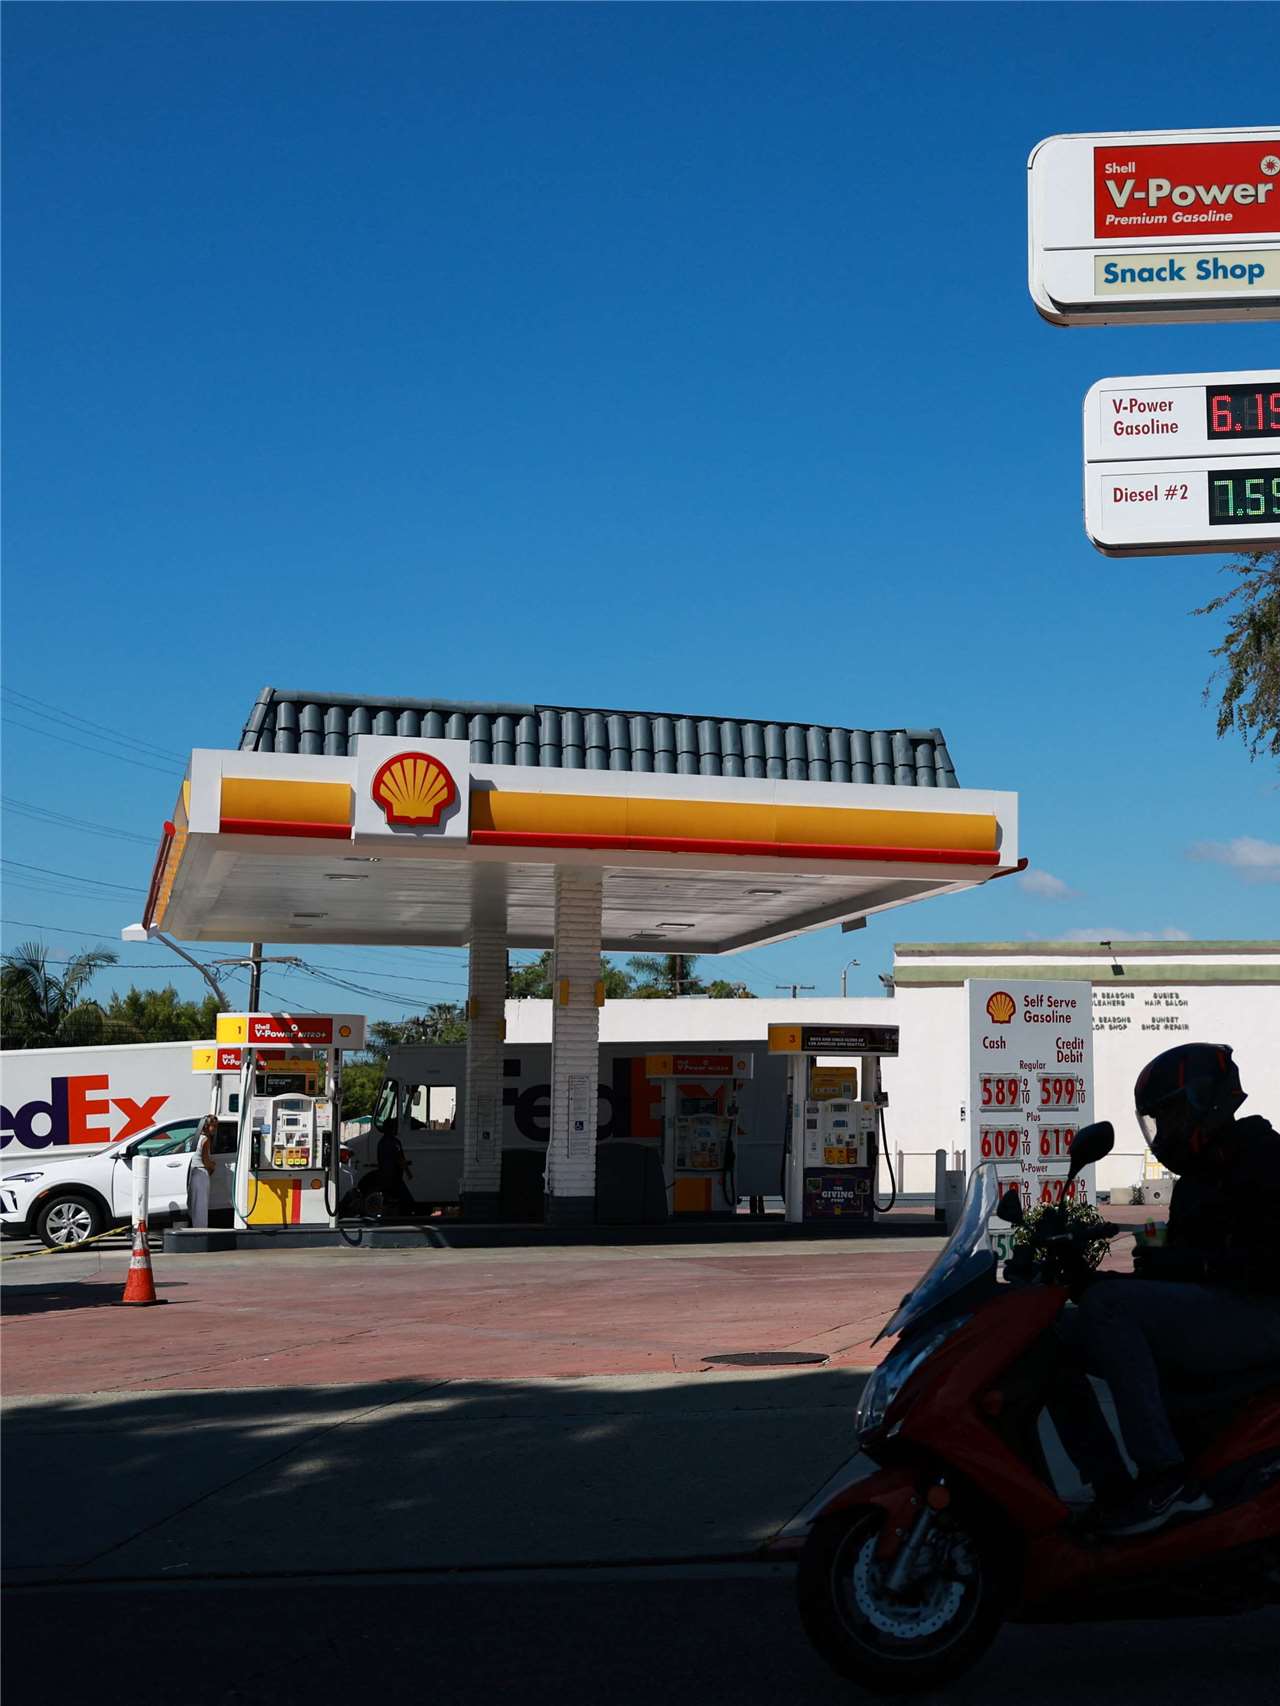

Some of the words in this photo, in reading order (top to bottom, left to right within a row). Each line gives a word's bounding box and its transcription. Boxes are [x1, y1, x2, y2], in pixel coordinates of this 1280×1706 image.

[1104, 162, 1136, 174] Shell
[1105, 178, 1274, 208] V-Power
[1105, 212, 1168, 225] Premium
[1172, 210, 1233, 224] Gasoline
[1104, 258, 1187, 284] Snack
[1196, 257, 1266, 285] Shop
[1112, 398, 1174, 414] V-Power
[1113, 418, 1179, 436] Gasoline
[1113, 484, 1158, 503] Diesel
[1164, 484, 1189, 501] #2
[1023, 994, 1044, 1008] Self
[1047, 996, 1077, 1008] Serve
[1023, 1010, 1072, 1023] Gasoline
[982, 1035, 1006, 1049] Cash
[1056, 1037, 1084, 1050] Credit
[1057, 1050, 1083, 1063] Debit
[1019, 1060, 1046, 1072] Regular
[982, 1078, 1018, 1104] 589
[1041, 1078, 1075, 1104] 599
[1026, 1112, 1041, 1122] Plus
[981, 1130, 1018, 1157] 609
[1021, 1163, 1048, 1173] V-Power
